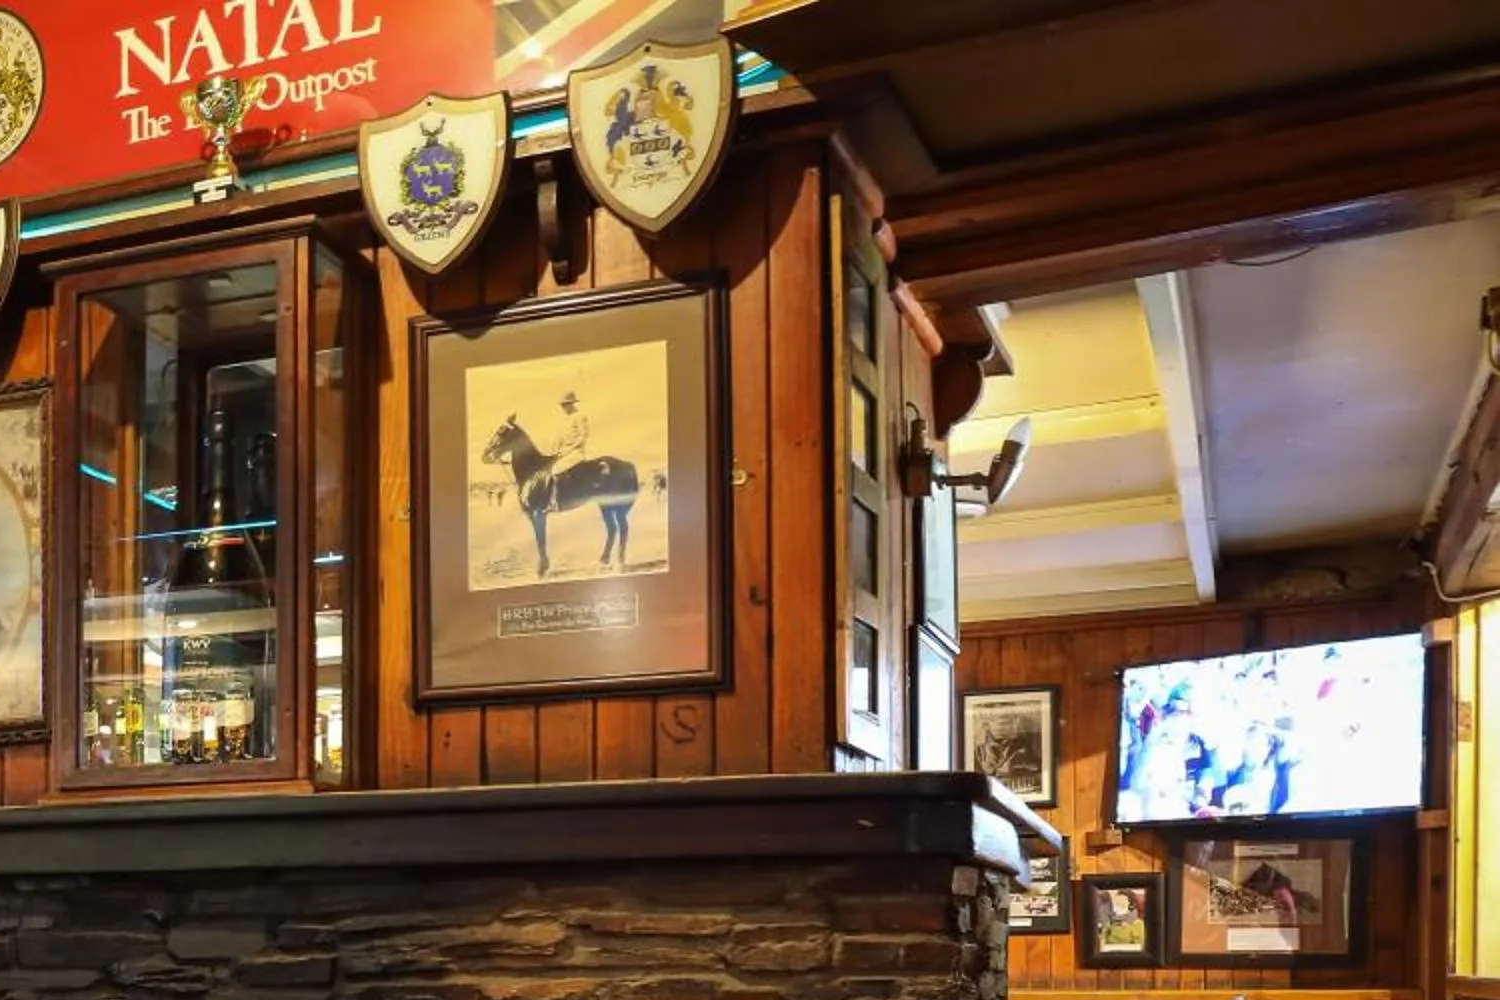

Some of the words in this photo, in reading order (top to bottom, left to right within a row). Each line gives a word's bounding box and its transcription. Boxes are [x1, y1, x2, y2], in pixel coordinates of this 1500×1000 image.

[114, 0, 382, 98] NATAL
[121, 105, 172, 145] The
[255, 58, 378, 112] Outpost
[183, 638, 211, 651] KWV
